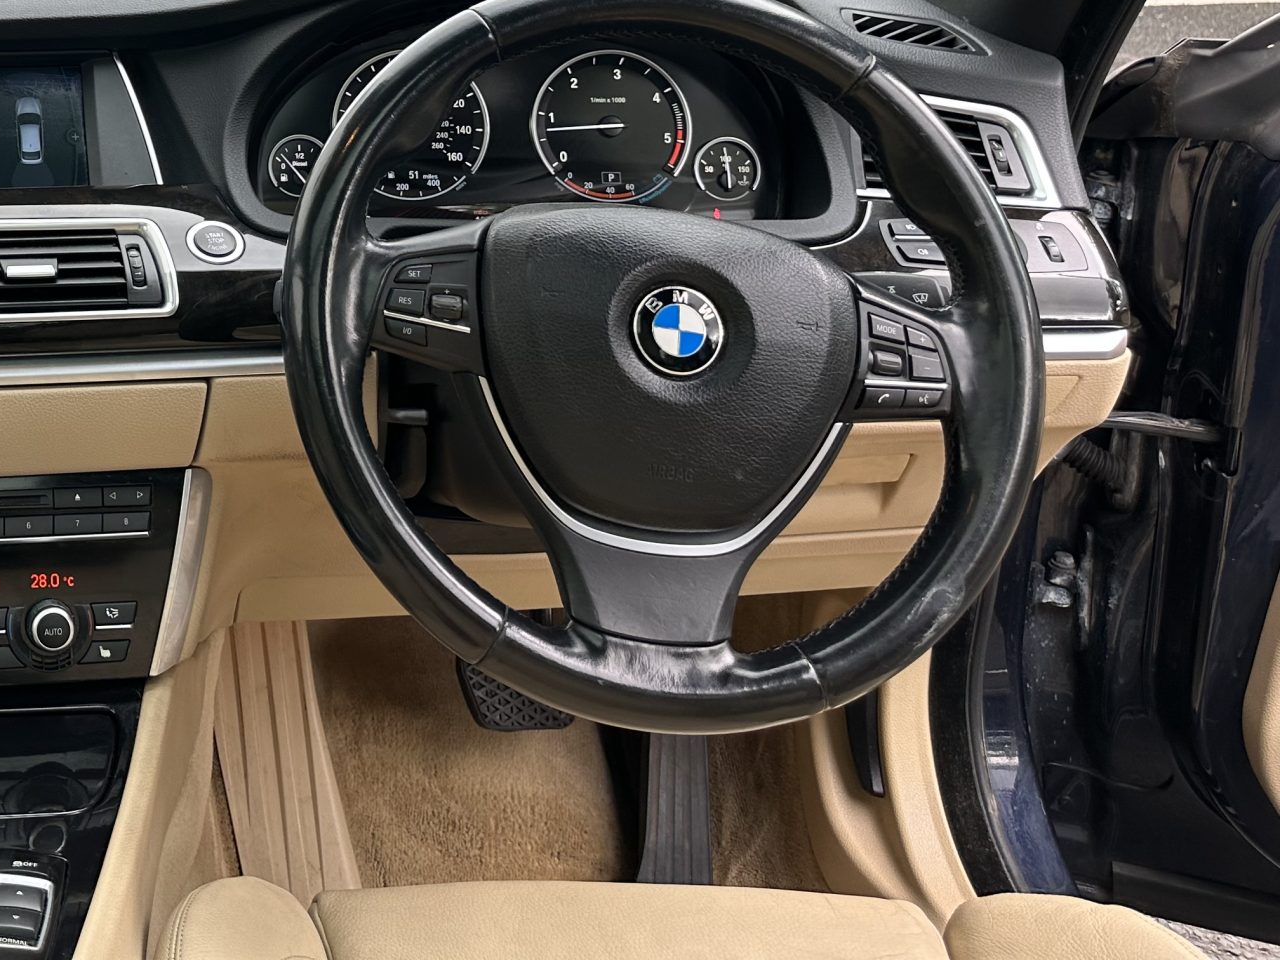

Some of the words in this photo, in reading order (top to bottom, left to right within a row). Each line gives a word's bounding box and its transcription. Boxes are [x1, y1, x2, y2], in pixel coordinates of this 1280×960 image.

[613, 69, 622, 80] 3
[570, 77, 578, 89] 2
[652, 92, 661, 103] 4
[548, 112, 555, 123] 1
[455, 125, 472, 135] 140
[436, 131, 449, 139] 240
[664, 132, 672, 144] 5
[431, 142, 445, 150] 260
[446, 152, 464, 162] 160
[559, 151, 568, 162] 0
[704, 165, 714, 173] 50
[737, 165, 750, 173] 150
[408, 170, 419, 180] 51
[608, 173, 615, 182] P
[396, 183, 409, 191] 200
[426, 179, 440, 187] 400
[584, 181, 593, 189] 20
[625, 183, 635, 191] 60
[606, 186, 615, 194] 40
[407, 270, 421, 278] SET
[398, 296, 412, 305] RES
[644, 290, 715, 321] BMW
[876, 324, 897, 335] MODE
[26, 521, 31, 529] 6
[75, 519, 80, 527] 7
[123, 517, 129, 526] 8
[30, 572, 60, 589] 28.0
[44, 627, 63, 636] AUTO
